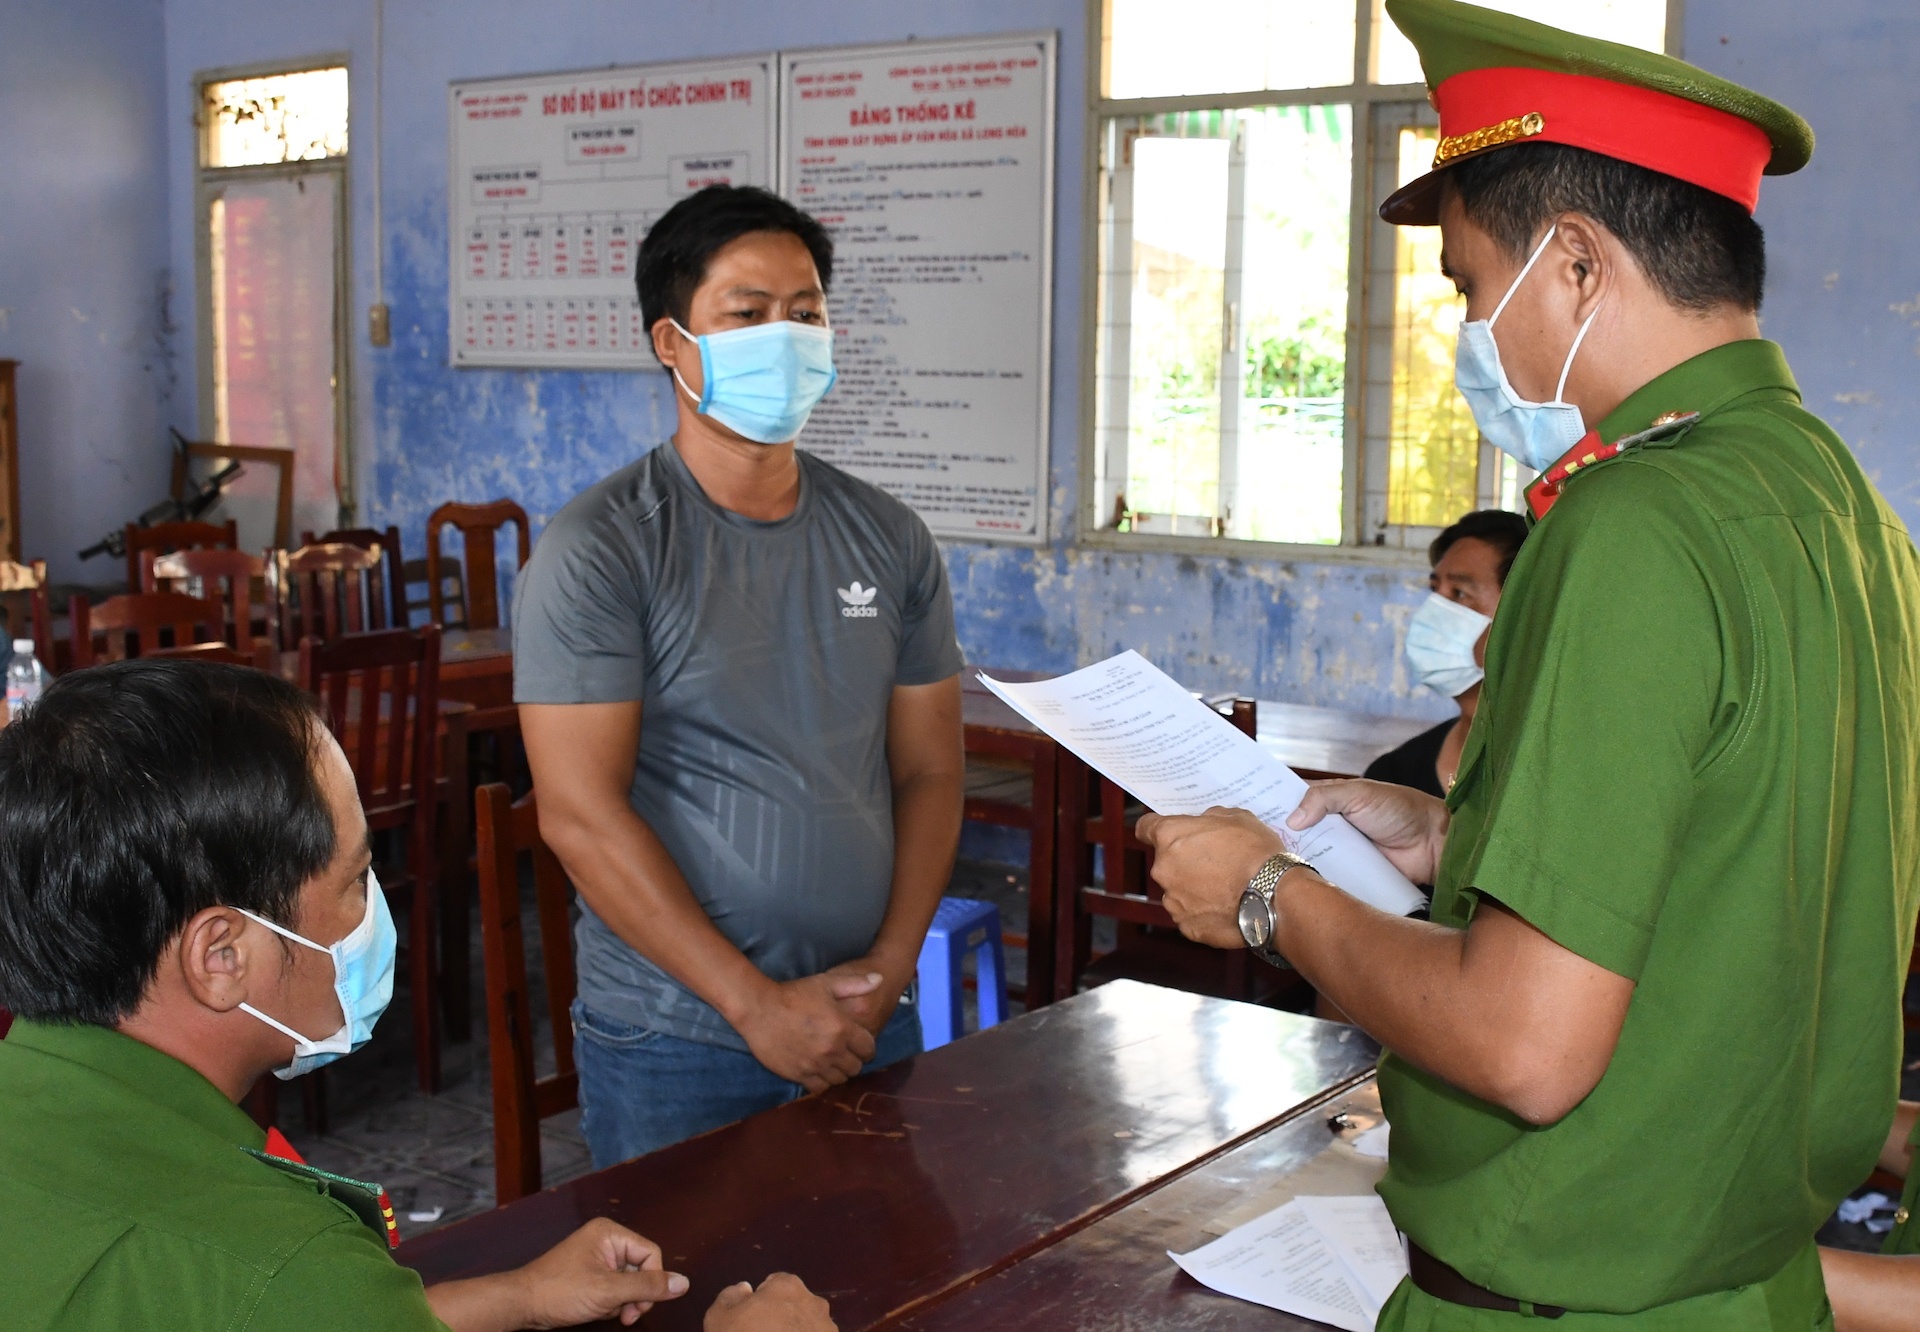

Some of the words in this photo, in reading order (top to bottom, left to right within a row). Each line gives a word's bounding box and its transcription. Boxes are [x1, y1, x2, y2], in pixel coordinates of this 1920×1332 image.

[850, 103, 891, 126] BẢNG
[897, 99, 949, 122] THỐNG
[954, 99, 976, 120] KÊ
[842, 605, 878, 618] adidas
